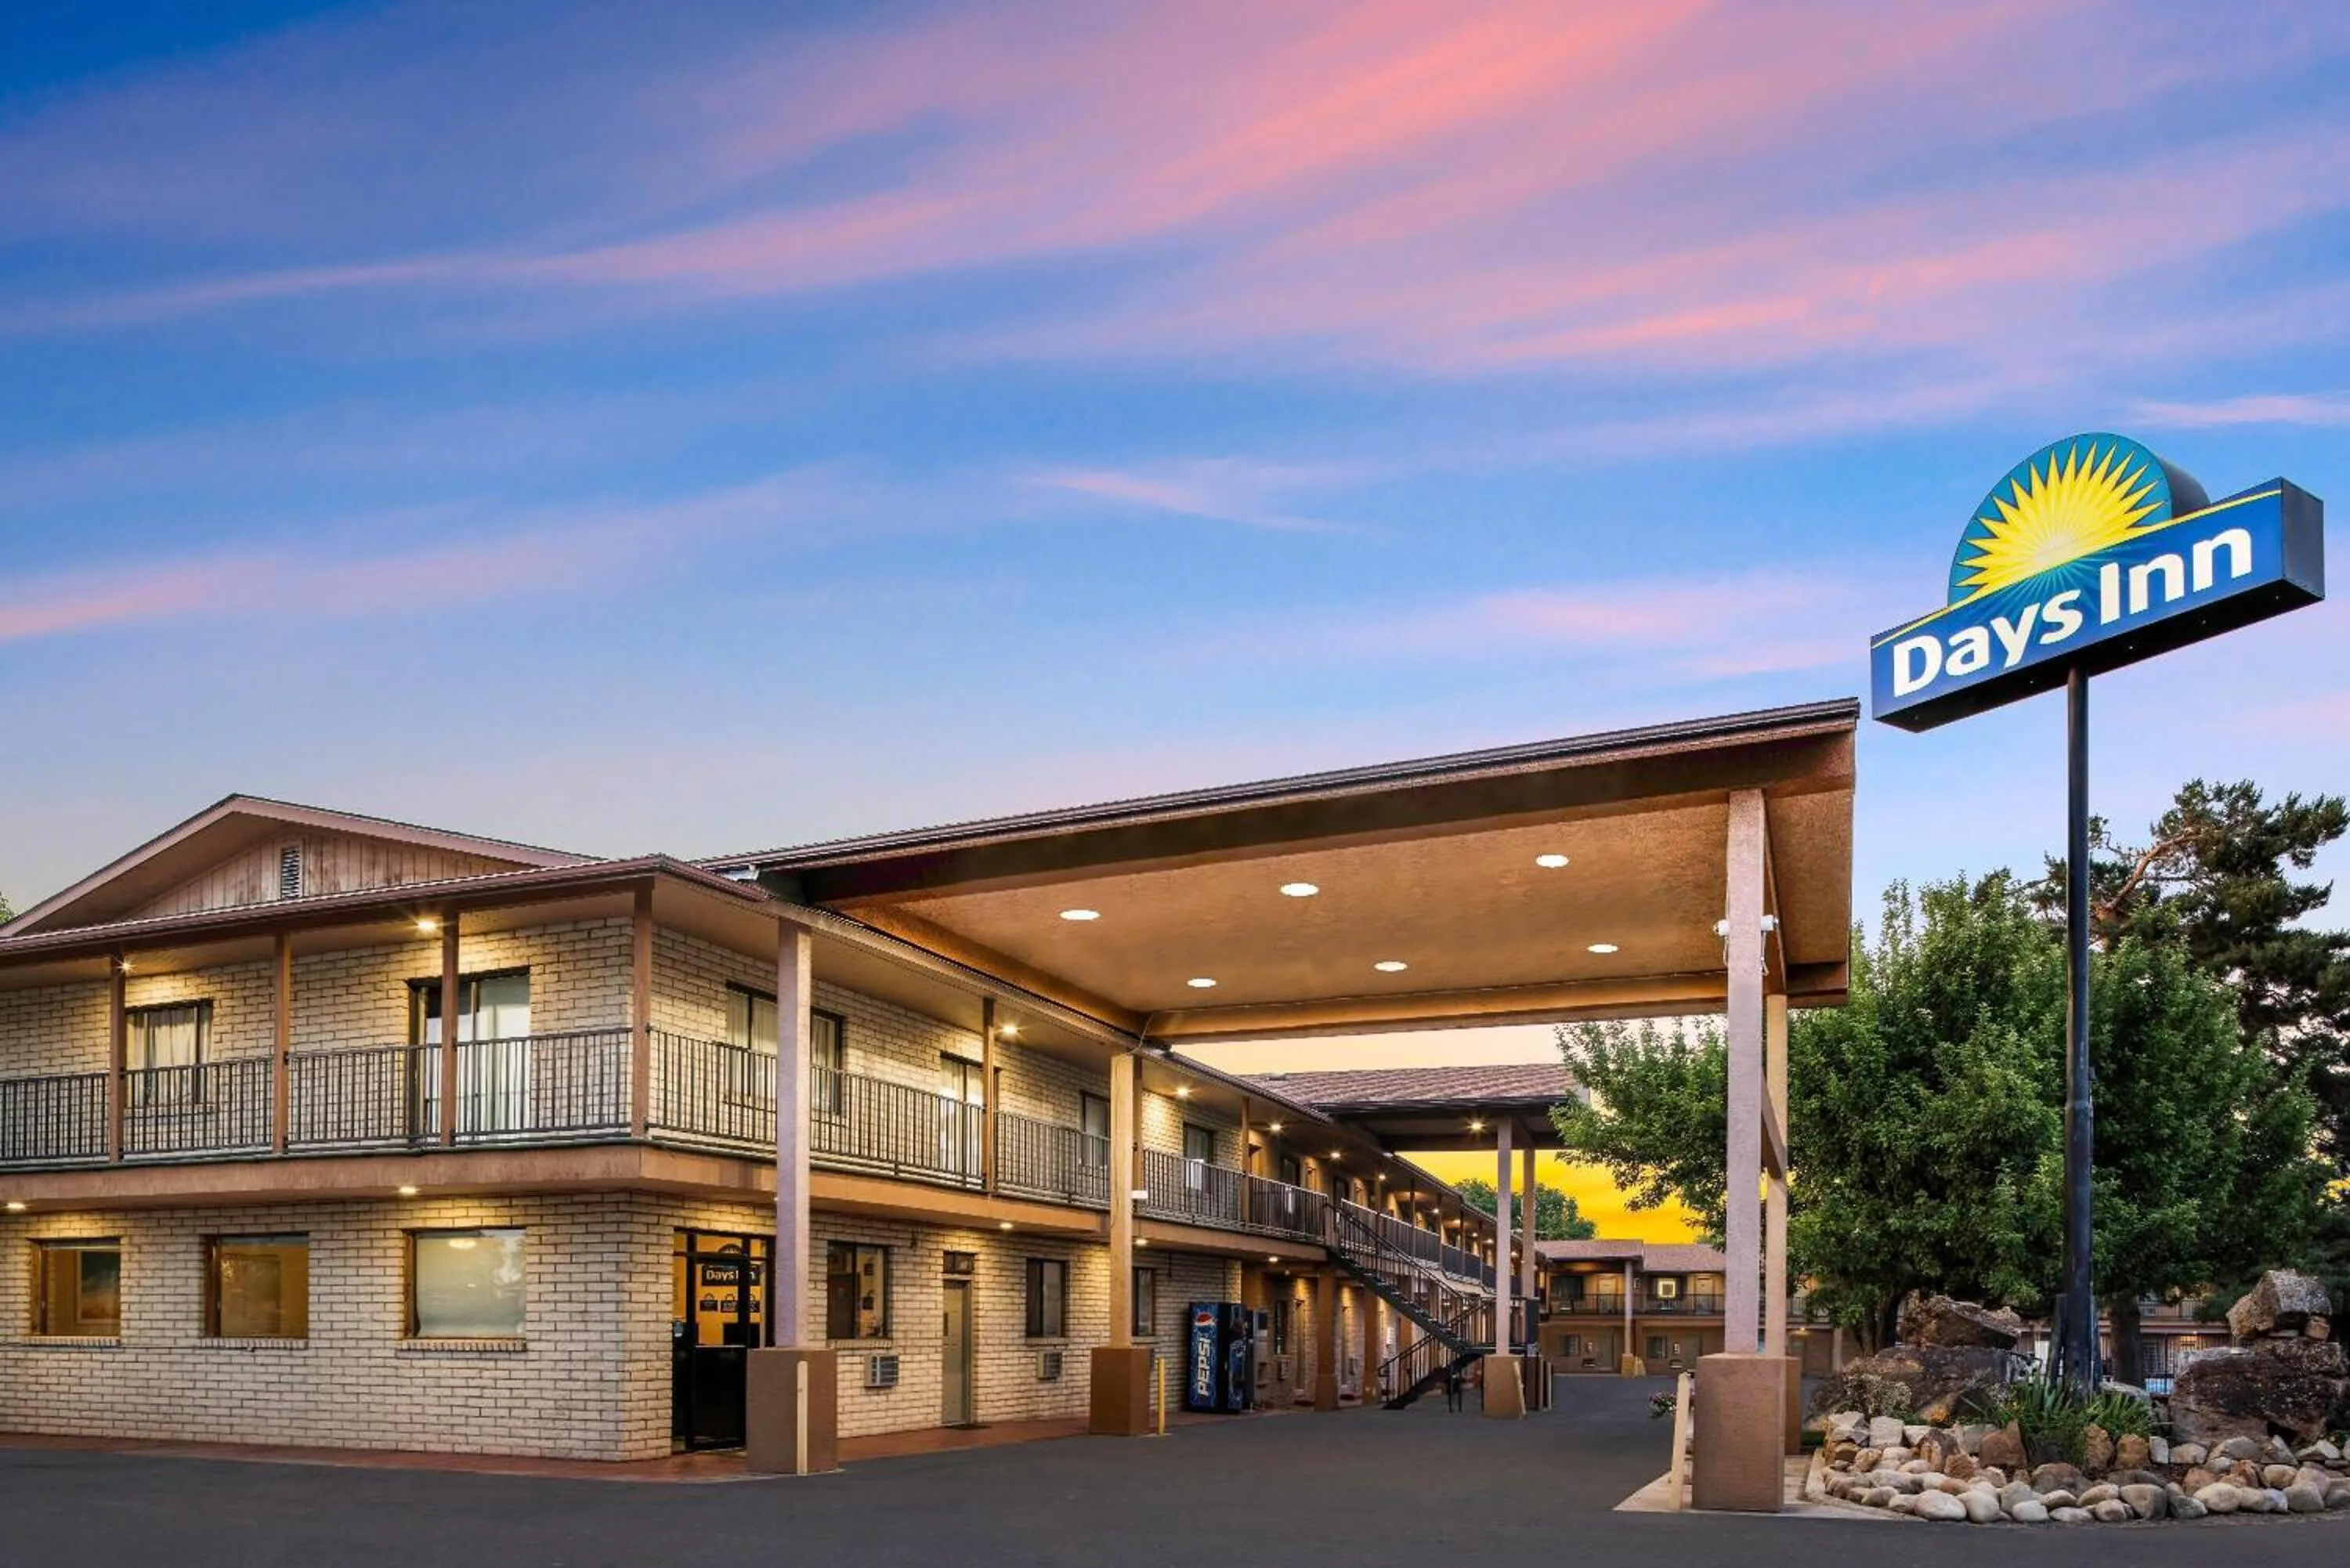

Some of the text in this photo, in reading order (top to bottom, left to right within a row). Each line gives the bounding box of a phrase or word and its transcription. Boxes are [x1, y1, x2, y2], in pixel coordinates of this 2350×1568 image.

[1893, 527, 2253, 697] Days Inn
[706, 1270, 755, 1281] Days In
[1198, 1336, 1210, 1396] PEPSI
